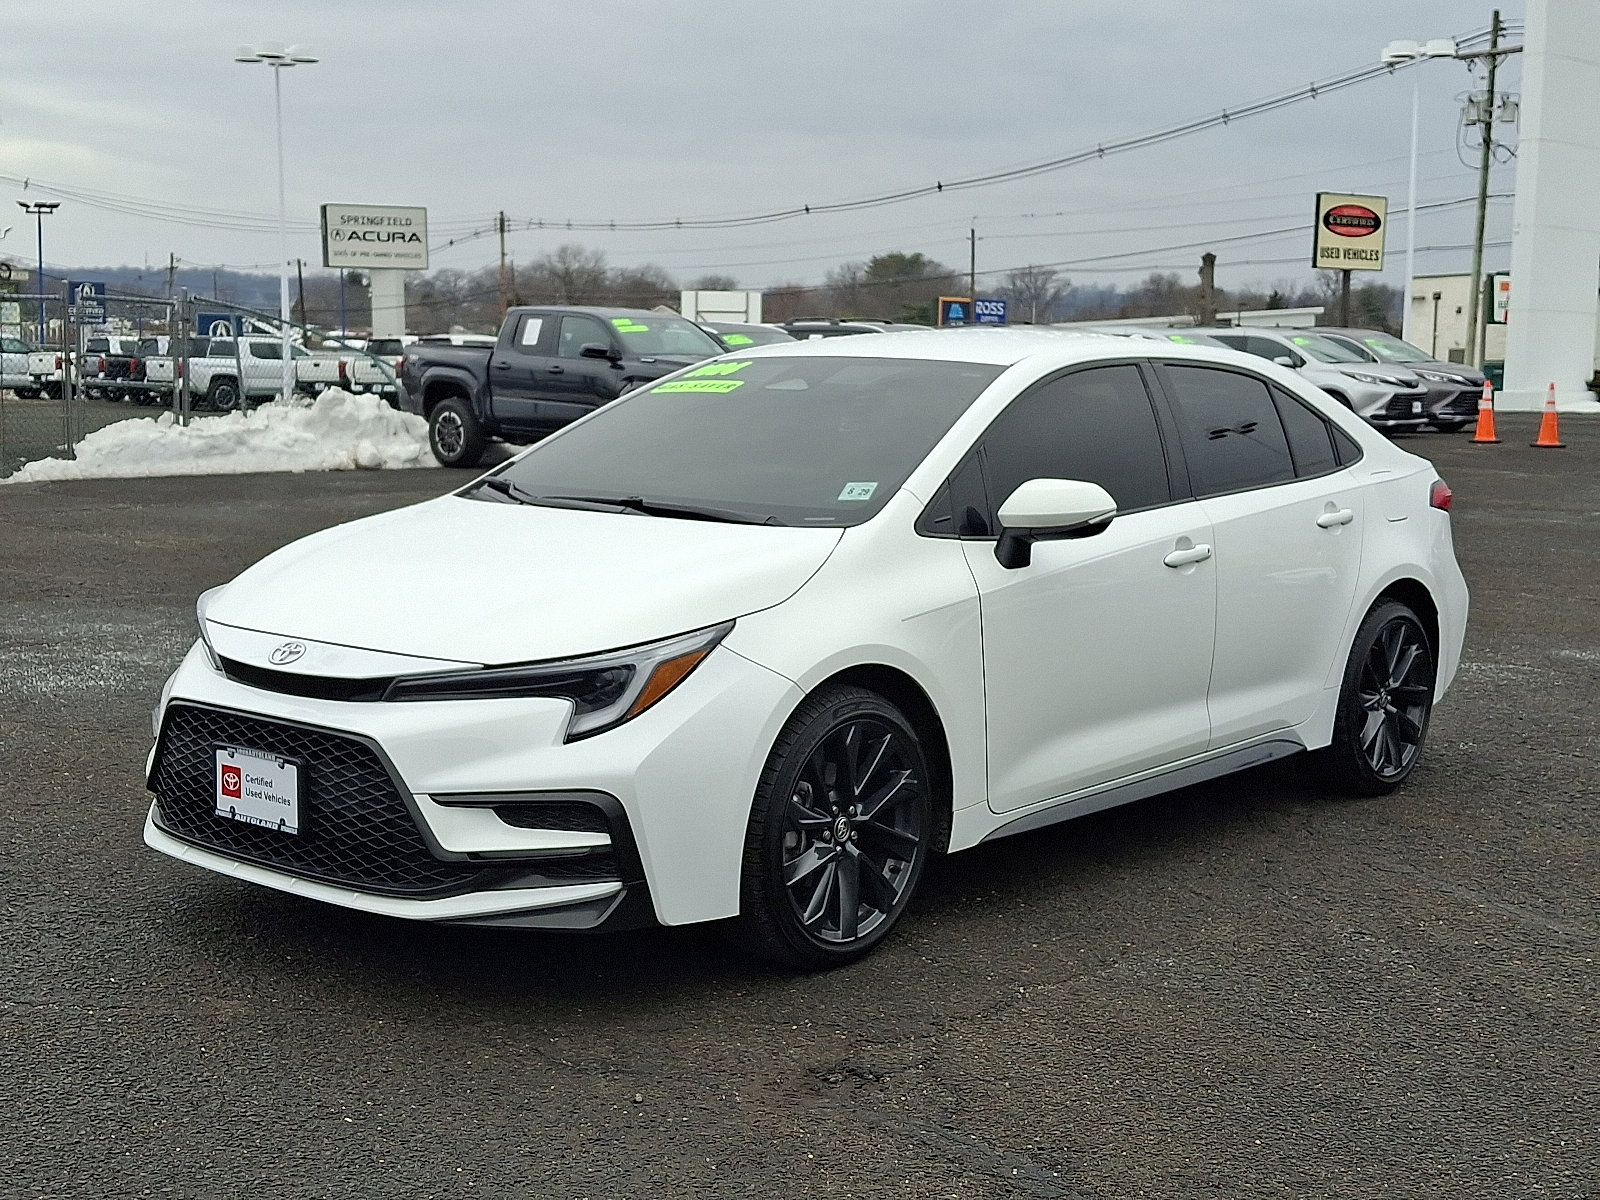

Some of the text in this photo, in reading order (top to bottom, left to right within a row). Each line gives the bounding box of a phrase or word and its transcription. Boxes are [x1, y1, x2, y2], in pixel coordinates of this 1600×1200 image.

[340, 215, 412, 226] SPRINGFIELD
[347, 230, 422, 243] ACURA
[1320, 247, 1379, 261] USED VEHICLES
[976, 301, 1005, 315] ROSS
[245, 773, 273, 788] Certified
[245, 786, 291, 807] Used Vehicles
[234, 813, 279, 831] AUTOLAND
